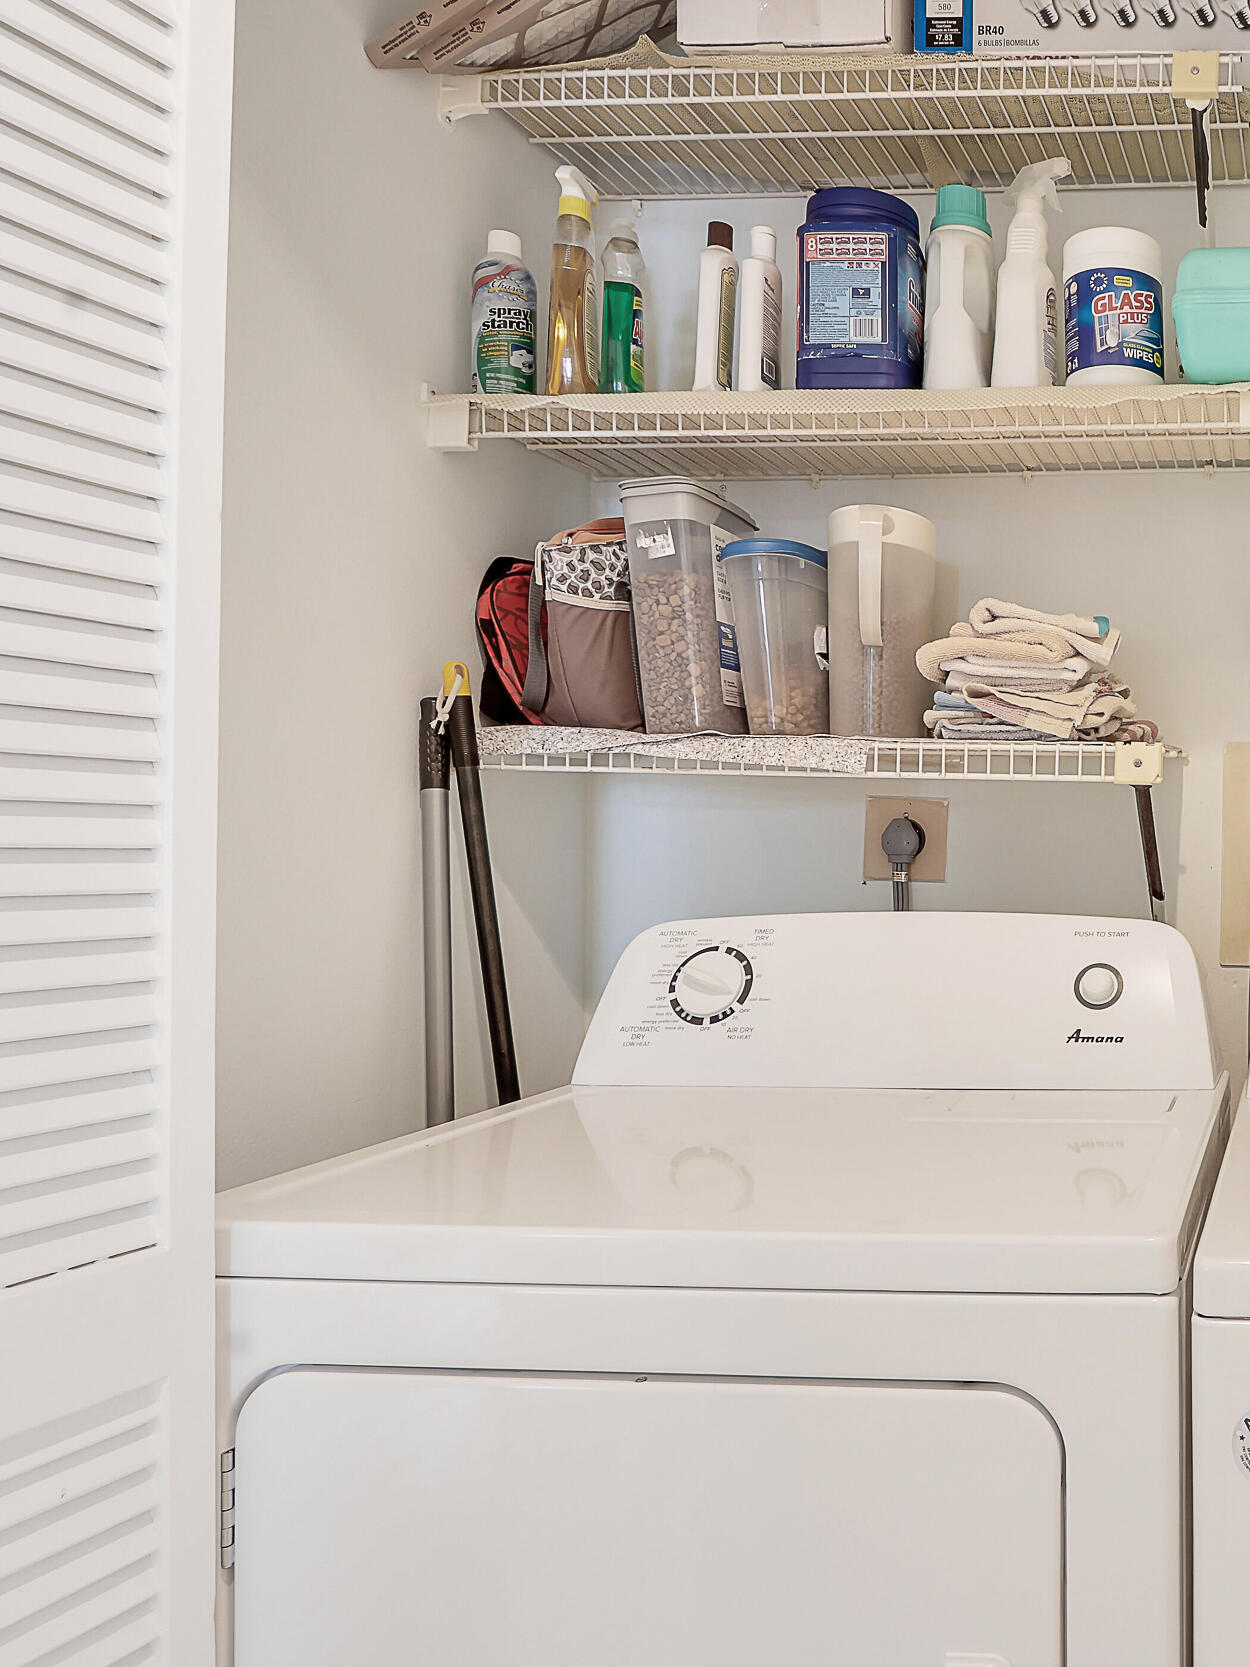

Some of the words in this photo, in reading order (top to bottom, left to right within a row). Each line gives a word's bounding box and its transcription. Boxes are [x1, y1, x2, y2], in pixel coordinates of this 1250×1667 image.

[938, 3, 952, 11] 580
[978, 25, 1004, 35] BR40
[1006, 39, 1040, 47] BOMBILLAS
[807, 237, 816, 250] 8
[1093, 291, 1154, 315] GLASS
[488, 307, 530, 320] spray
[1119, 313, 1148, 324] PLUS
[481, 318, 533, 333] starch
[1123, 348, 1154, 363] WIPES
[1066, 1028, 1125, 1044] Amana
